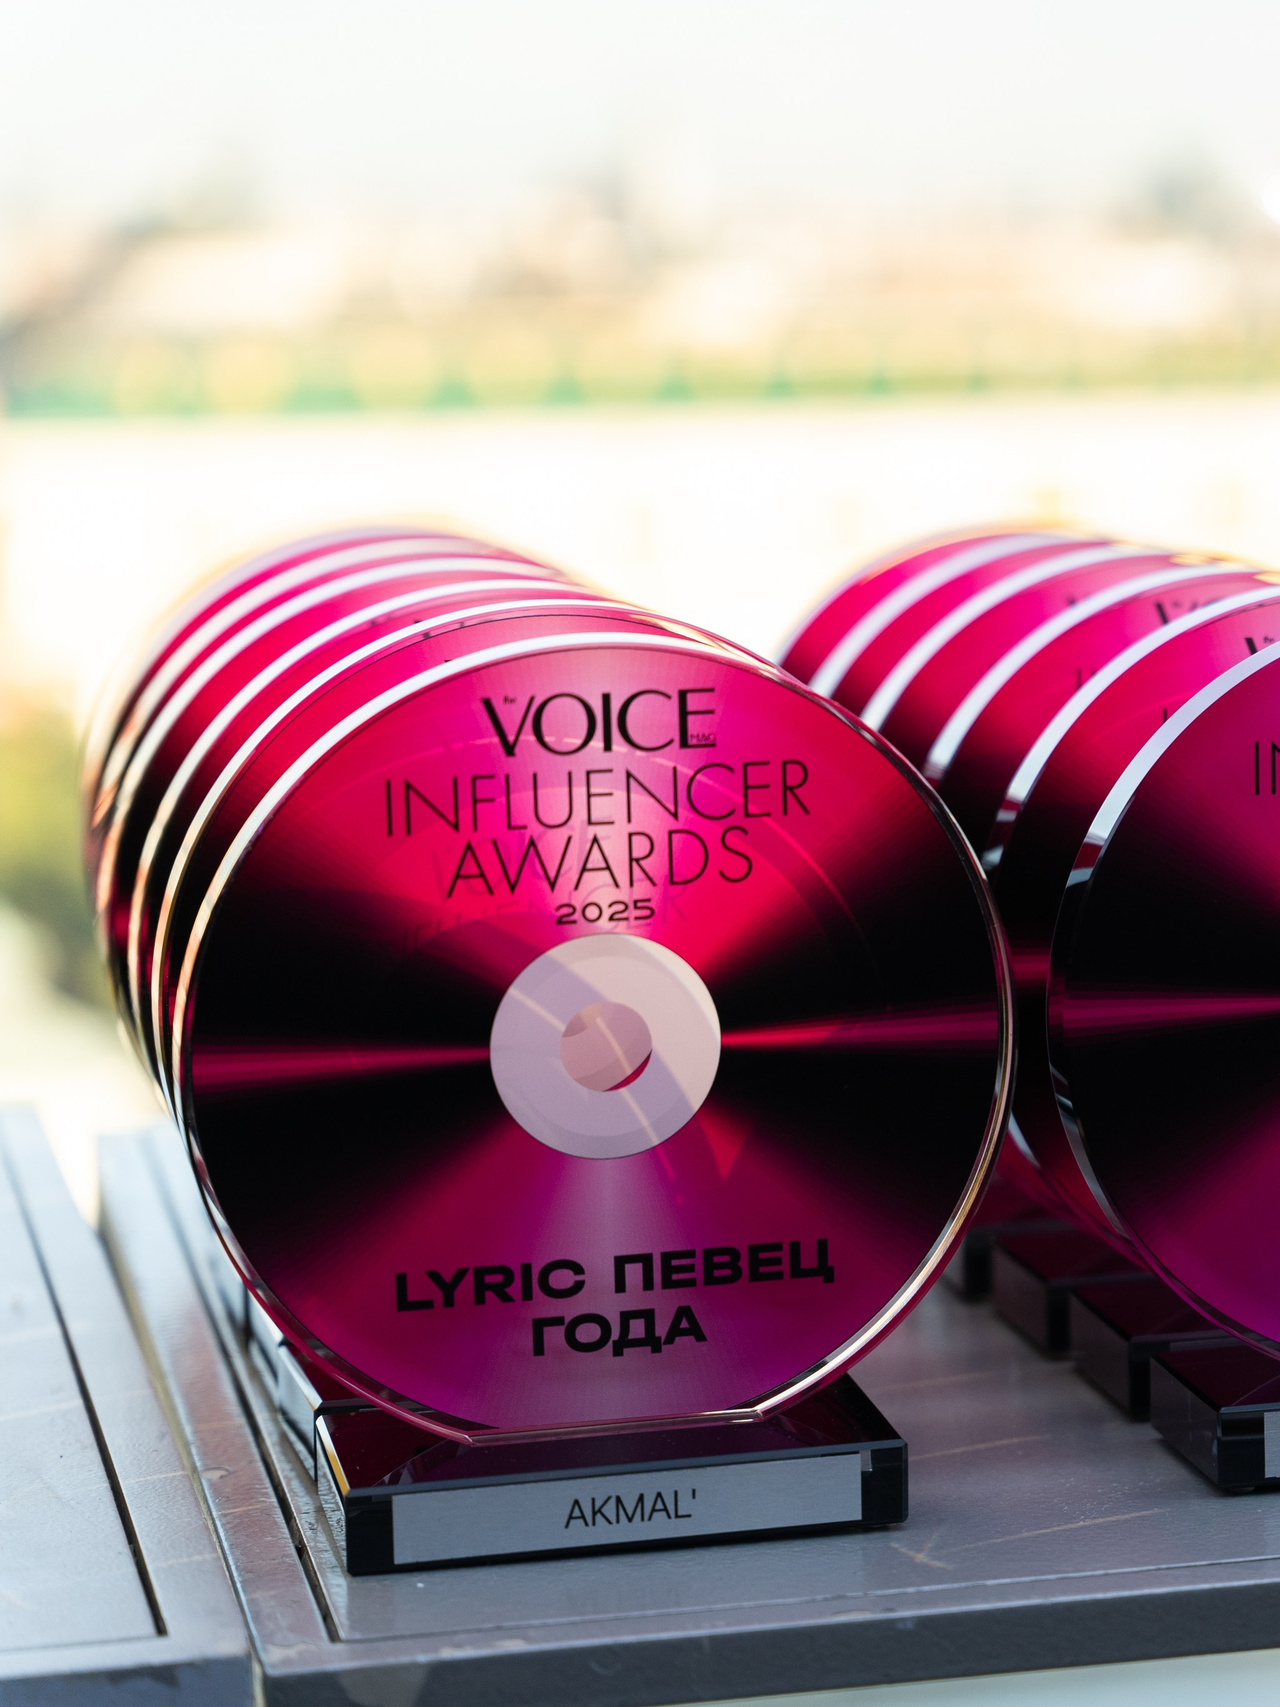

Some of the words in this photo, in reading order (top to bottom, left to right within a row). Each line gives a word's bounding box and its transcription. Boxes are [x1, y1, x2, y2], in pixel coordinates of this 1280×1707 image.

[481, 688, 717, 757] VOICE
[385, 760, 811, 837] INFLUENCER
[446, 825, 753, 898] AWARDS
[555, 899, 656, 926] 2025
[395, 1259, 586, 1313] LYRIC
[613, 1238, 835, 1294] ПЕВЕЦ
[532, 1305, 707, 1358] ГОДА
